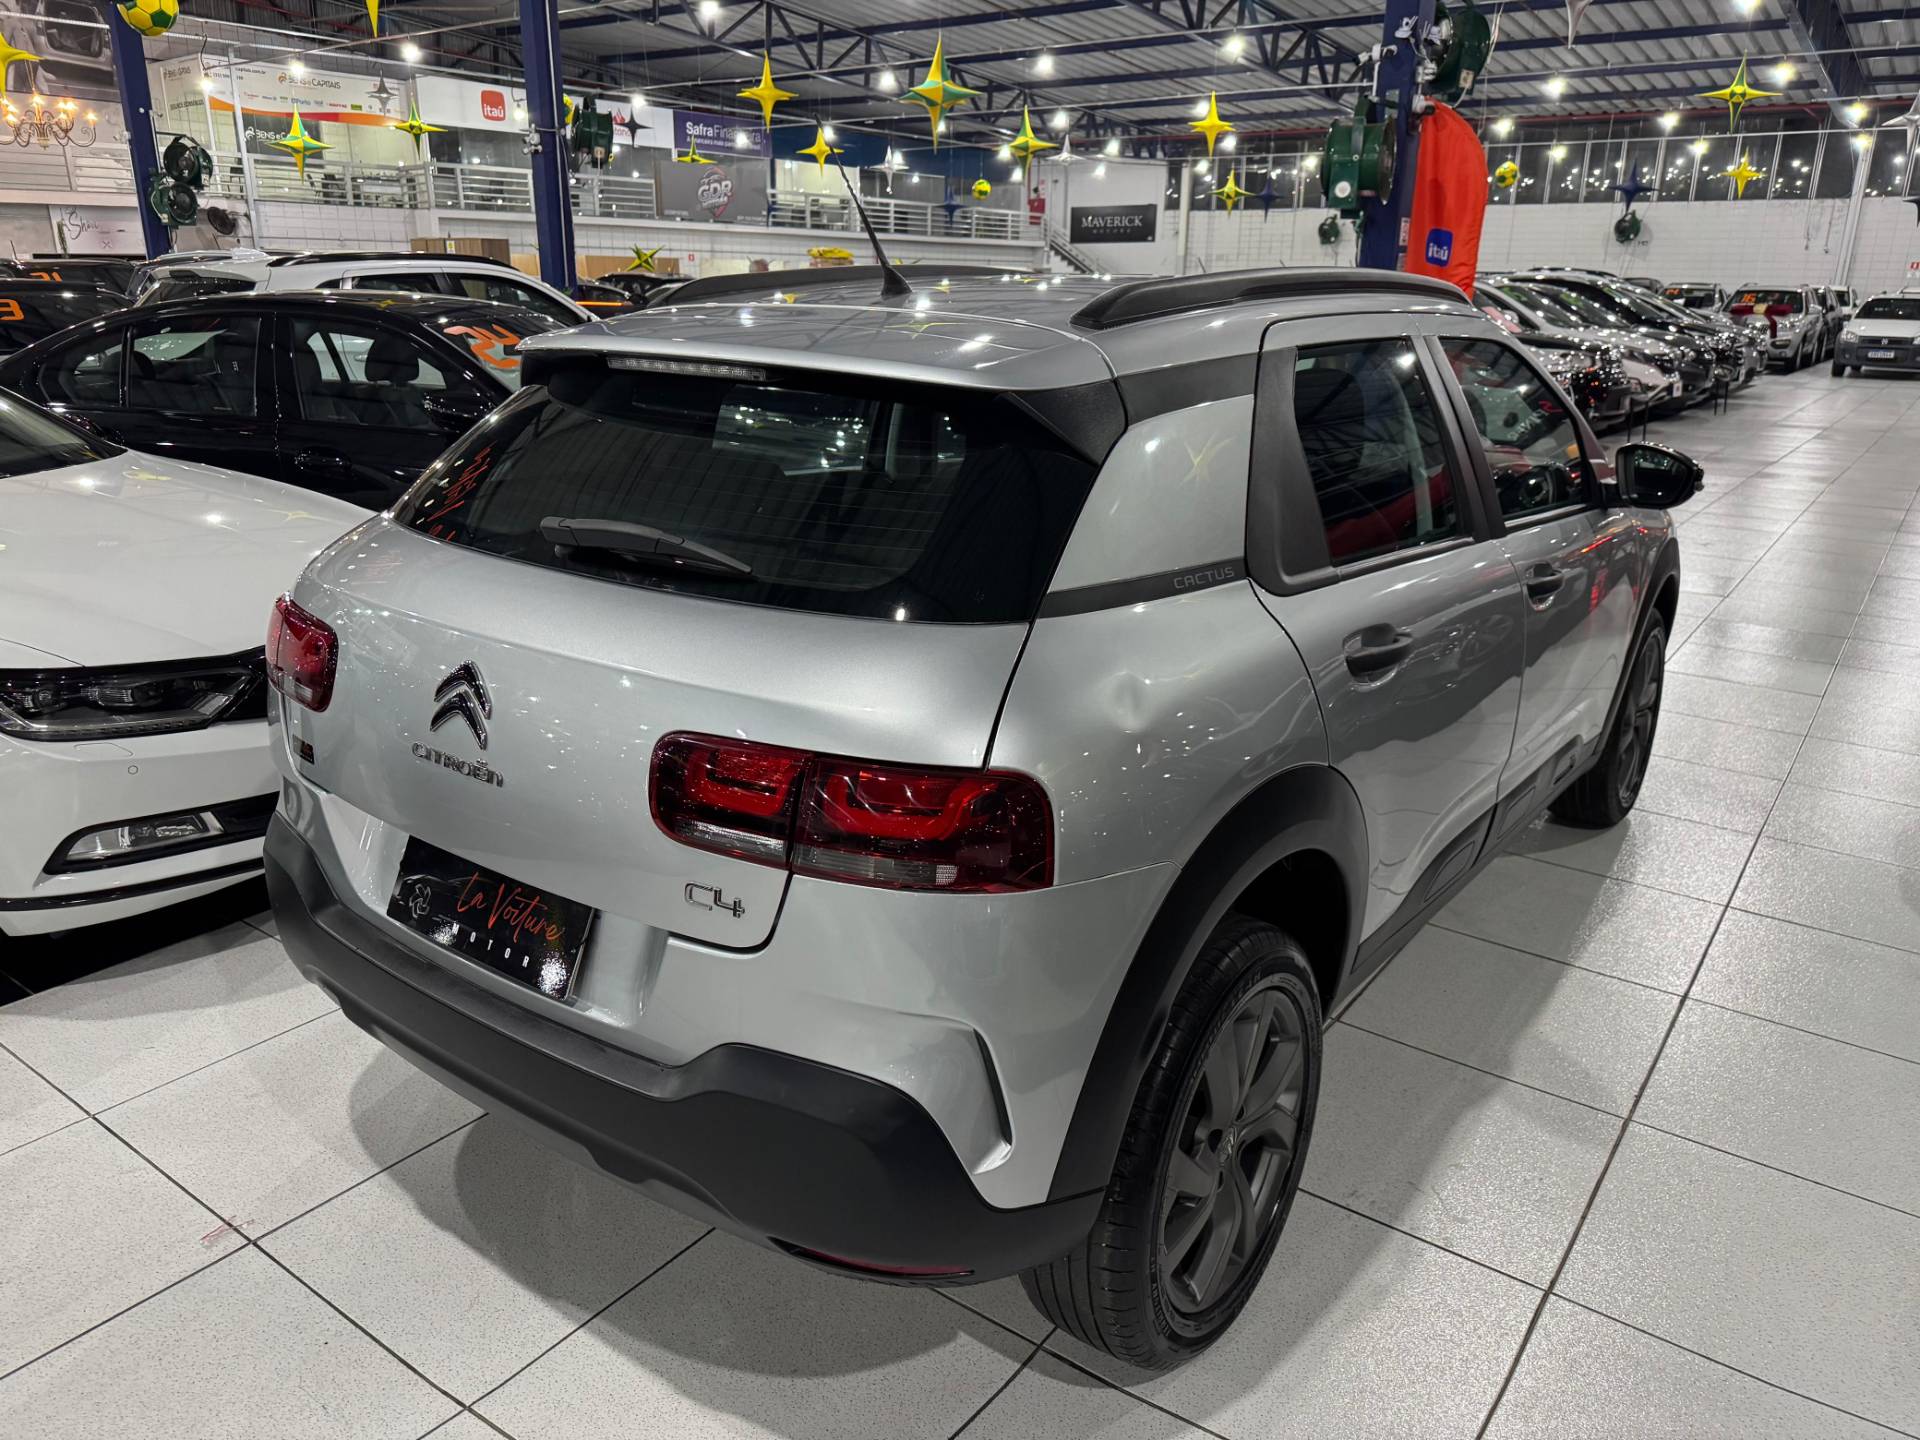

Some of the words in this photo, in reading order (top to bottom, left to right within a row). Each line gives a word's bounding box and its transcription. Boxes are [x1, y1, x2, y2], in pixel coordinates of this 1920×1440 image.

[483, 103, 504, 118] itaú
[697, 180, 732, 202] GDR
[1081, 215, 1143, 228] MAVERICK
[1427, 242, 1449, 261] itaú
[1173, 566, 1235, 589] CACTUS
[456, 871, 487, 913] La
[487, 883, 566, 944] Voiture
[684, 882, 746, 919] C4
[451, 922, 530, 968] MOTOR
